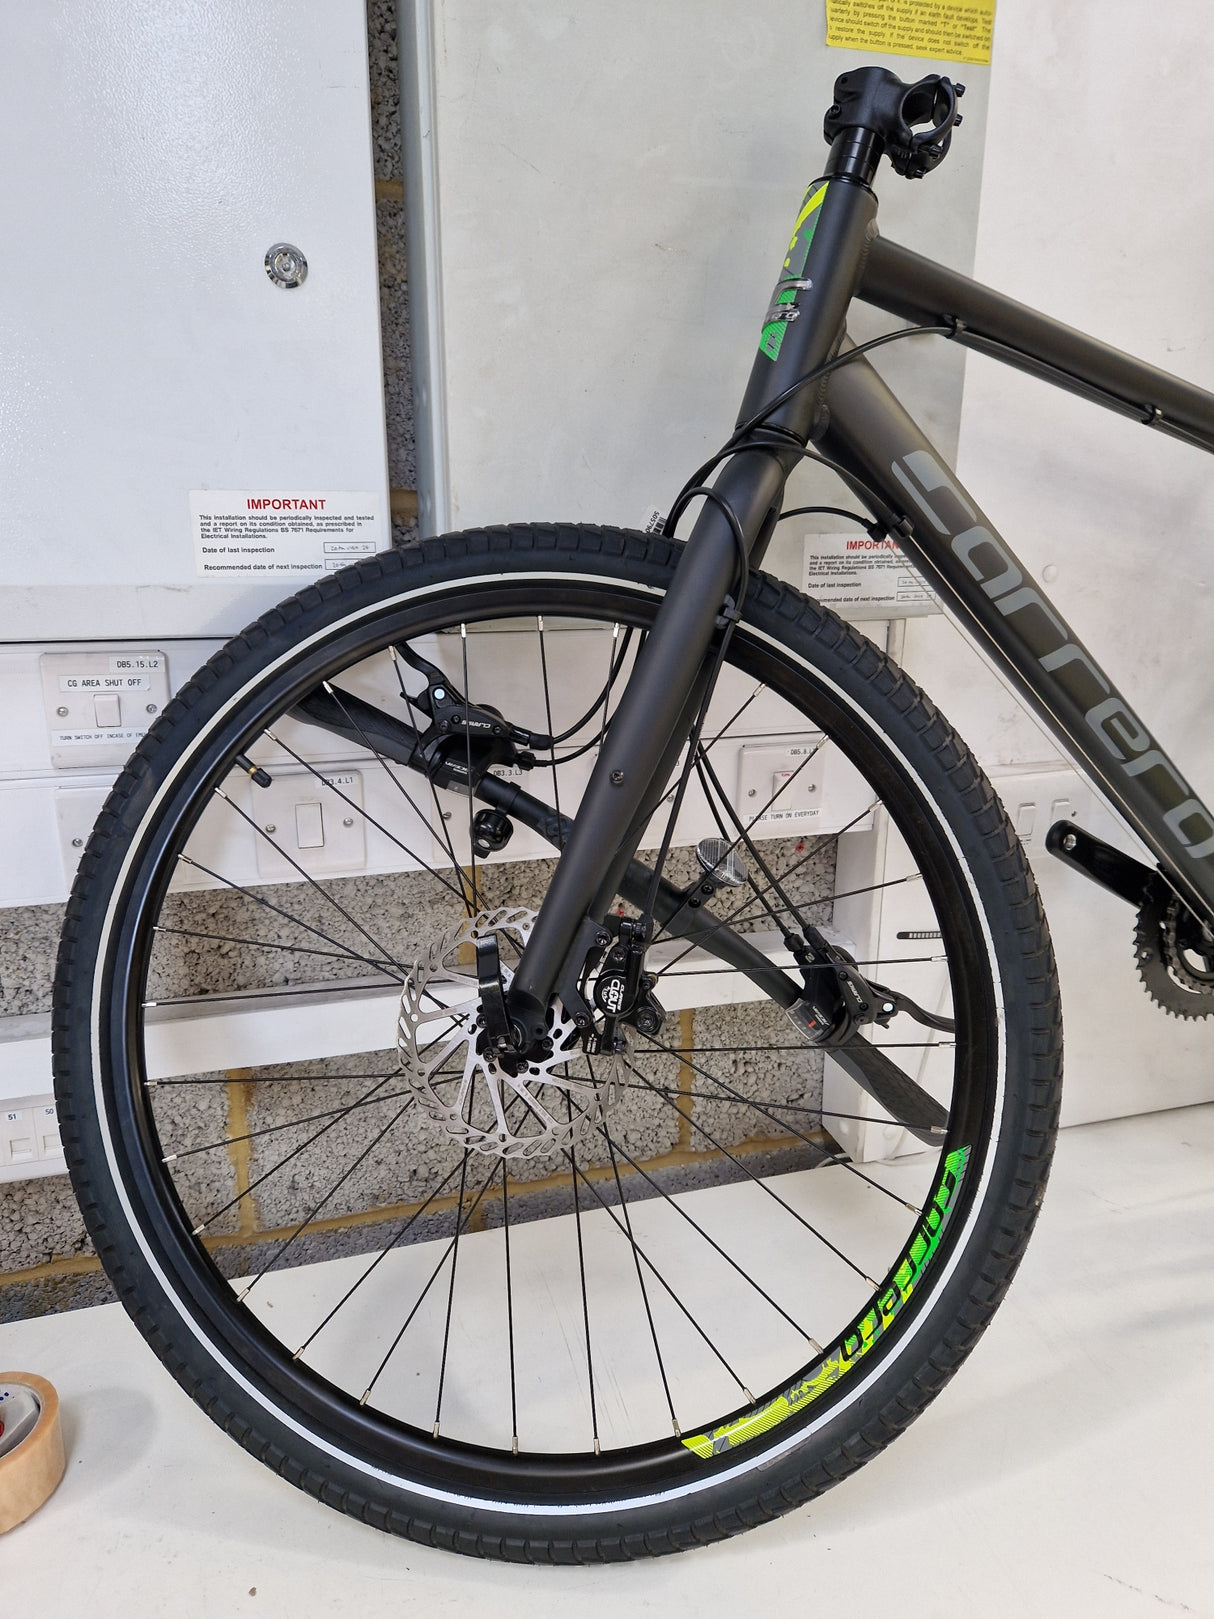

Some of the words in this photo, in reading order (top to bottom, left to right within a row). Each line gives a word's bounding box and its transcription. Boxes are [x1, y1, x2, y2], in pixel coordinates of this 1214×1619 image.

[247, 499, 326, 510] IMPORTANT
[846, 541, 900, 550] IMPORTAN
[117, 660, 159, 668] DB5.15.L2
